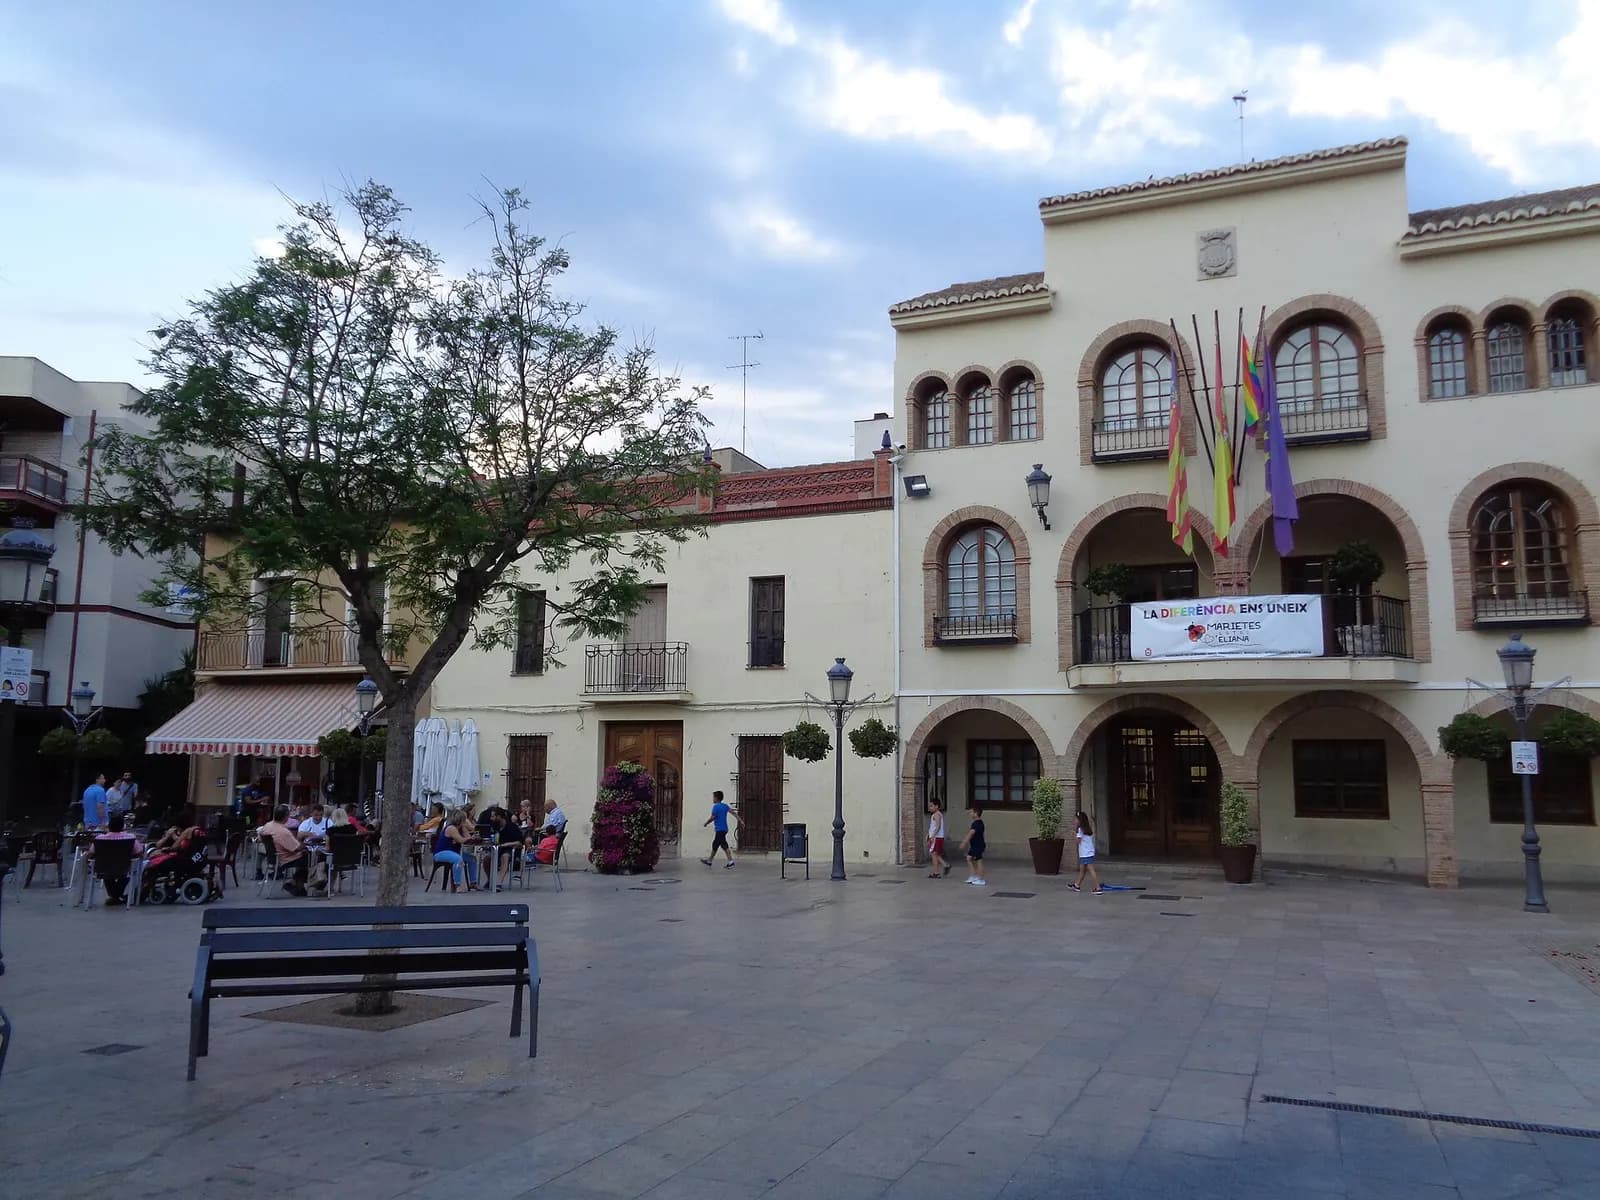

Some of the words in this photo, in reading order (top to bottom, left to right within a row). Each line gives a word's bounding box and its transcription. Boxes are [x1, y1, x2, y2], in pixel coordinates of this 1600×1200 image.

[1143, 609, 1158, 620] LA
[1161, 604, 1235, 619] DIFERÈNCIA
[1239, 603, 1263, 614] ENS
[1267, 603, 1308, 613] UNEIX
[1206, 621, 1261, 631] MARIETES
[237, 743, 261, 754] BAR
